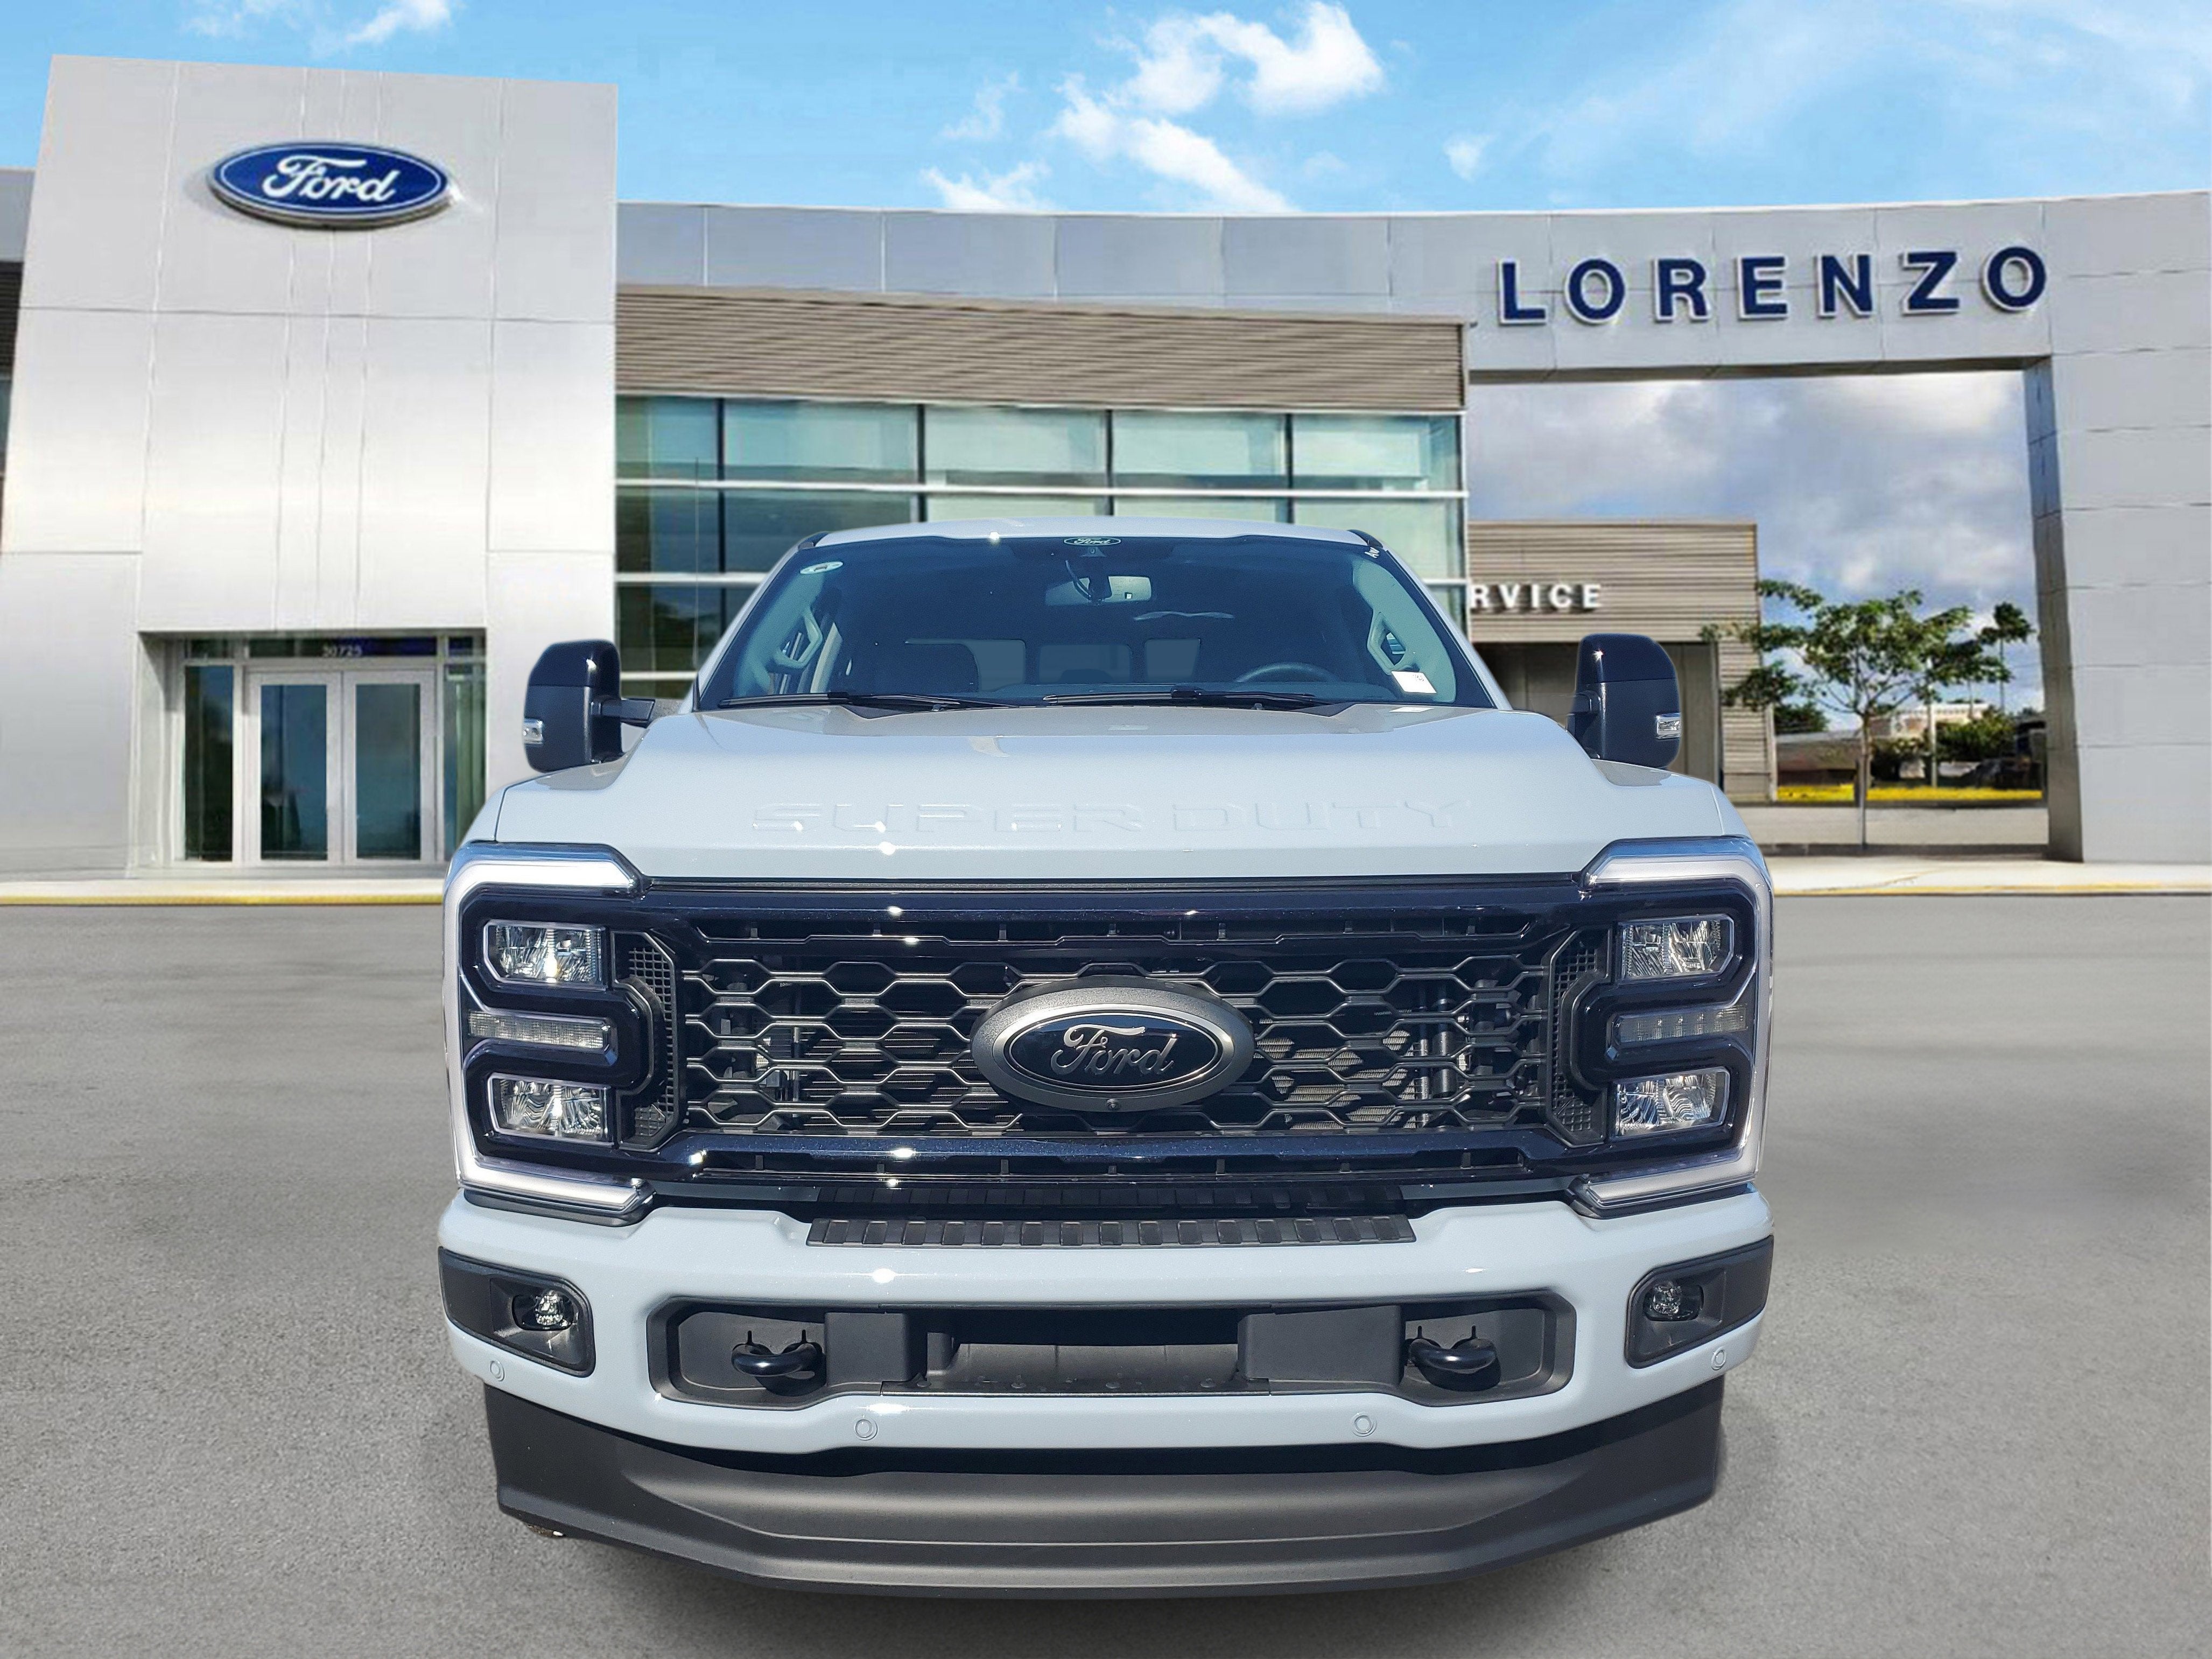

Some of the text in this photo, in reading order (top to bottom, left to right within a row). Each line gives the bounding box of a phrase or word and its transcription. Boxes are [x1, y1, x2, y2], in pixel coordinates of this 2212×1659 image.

[262, 155, 400, 201] Ford
[1498, 246, 2046, 324] LORENZO
[752, 799, 1472, 833] SUPER DUTY
[1050, 1024, 1178, 1075] Ford
